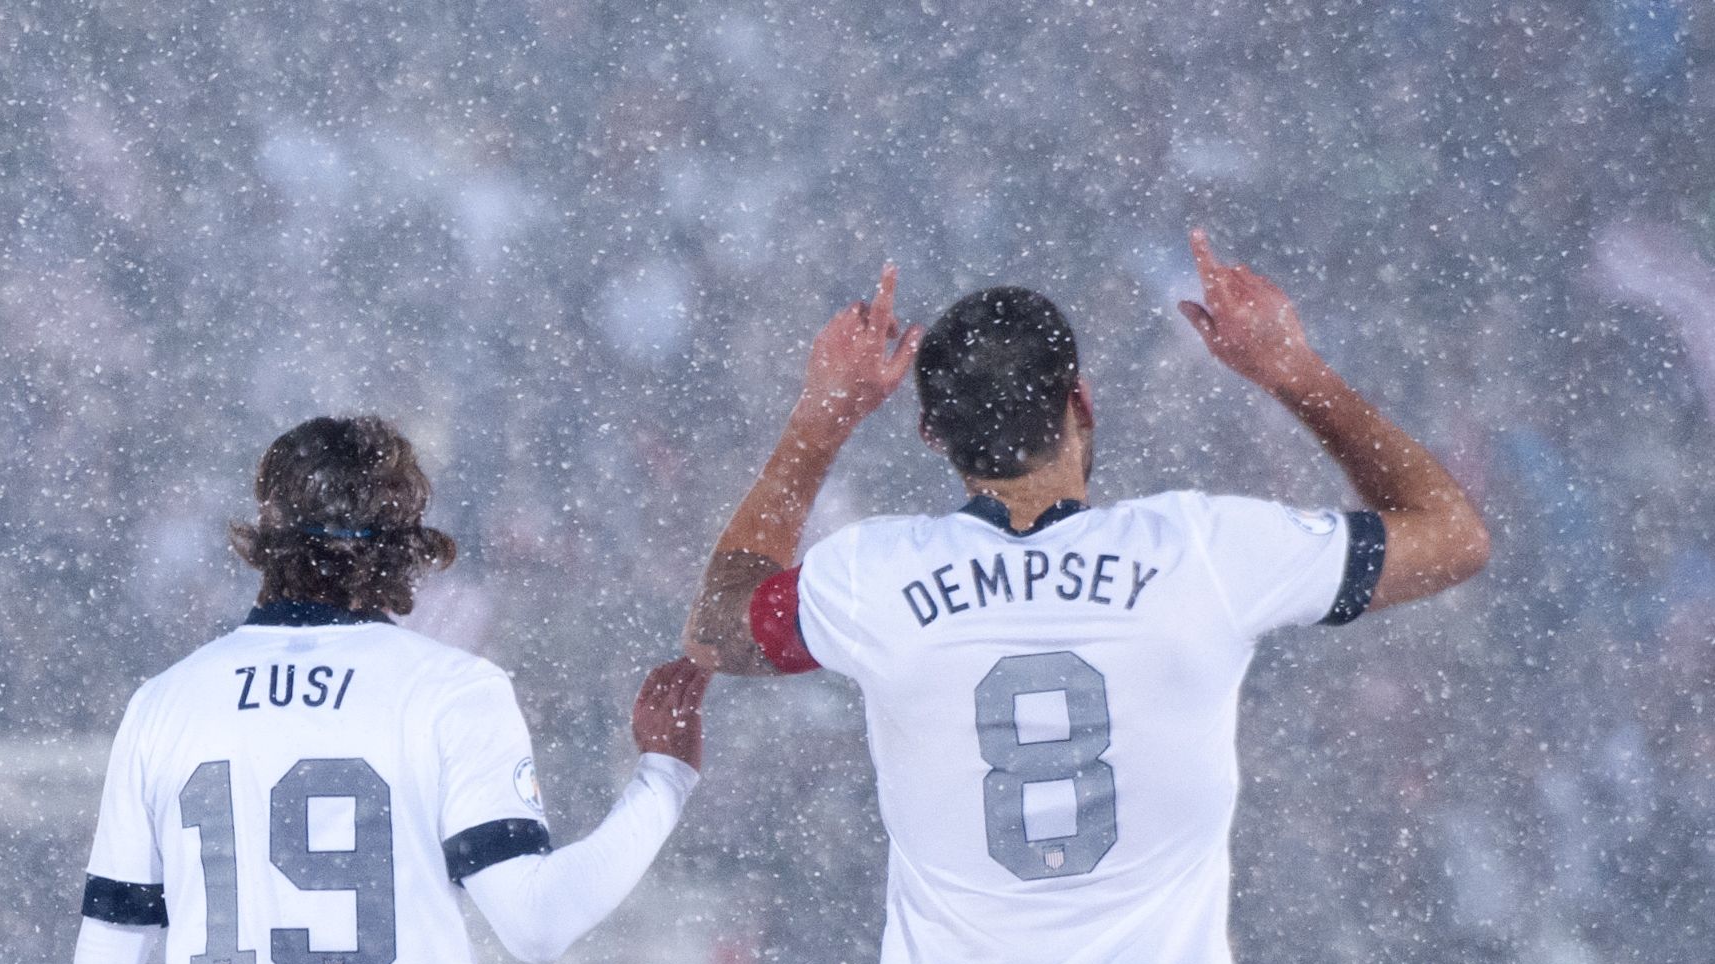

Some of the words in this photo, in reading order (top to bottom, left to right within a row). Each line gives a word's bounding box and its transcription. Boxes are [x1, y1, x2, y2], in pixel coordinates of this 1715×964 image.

[901, 550, 1158, 628] DEMPSEY
[234, 663, 355, 711] ZUSI
[973, 650, 1118, 881] 8
